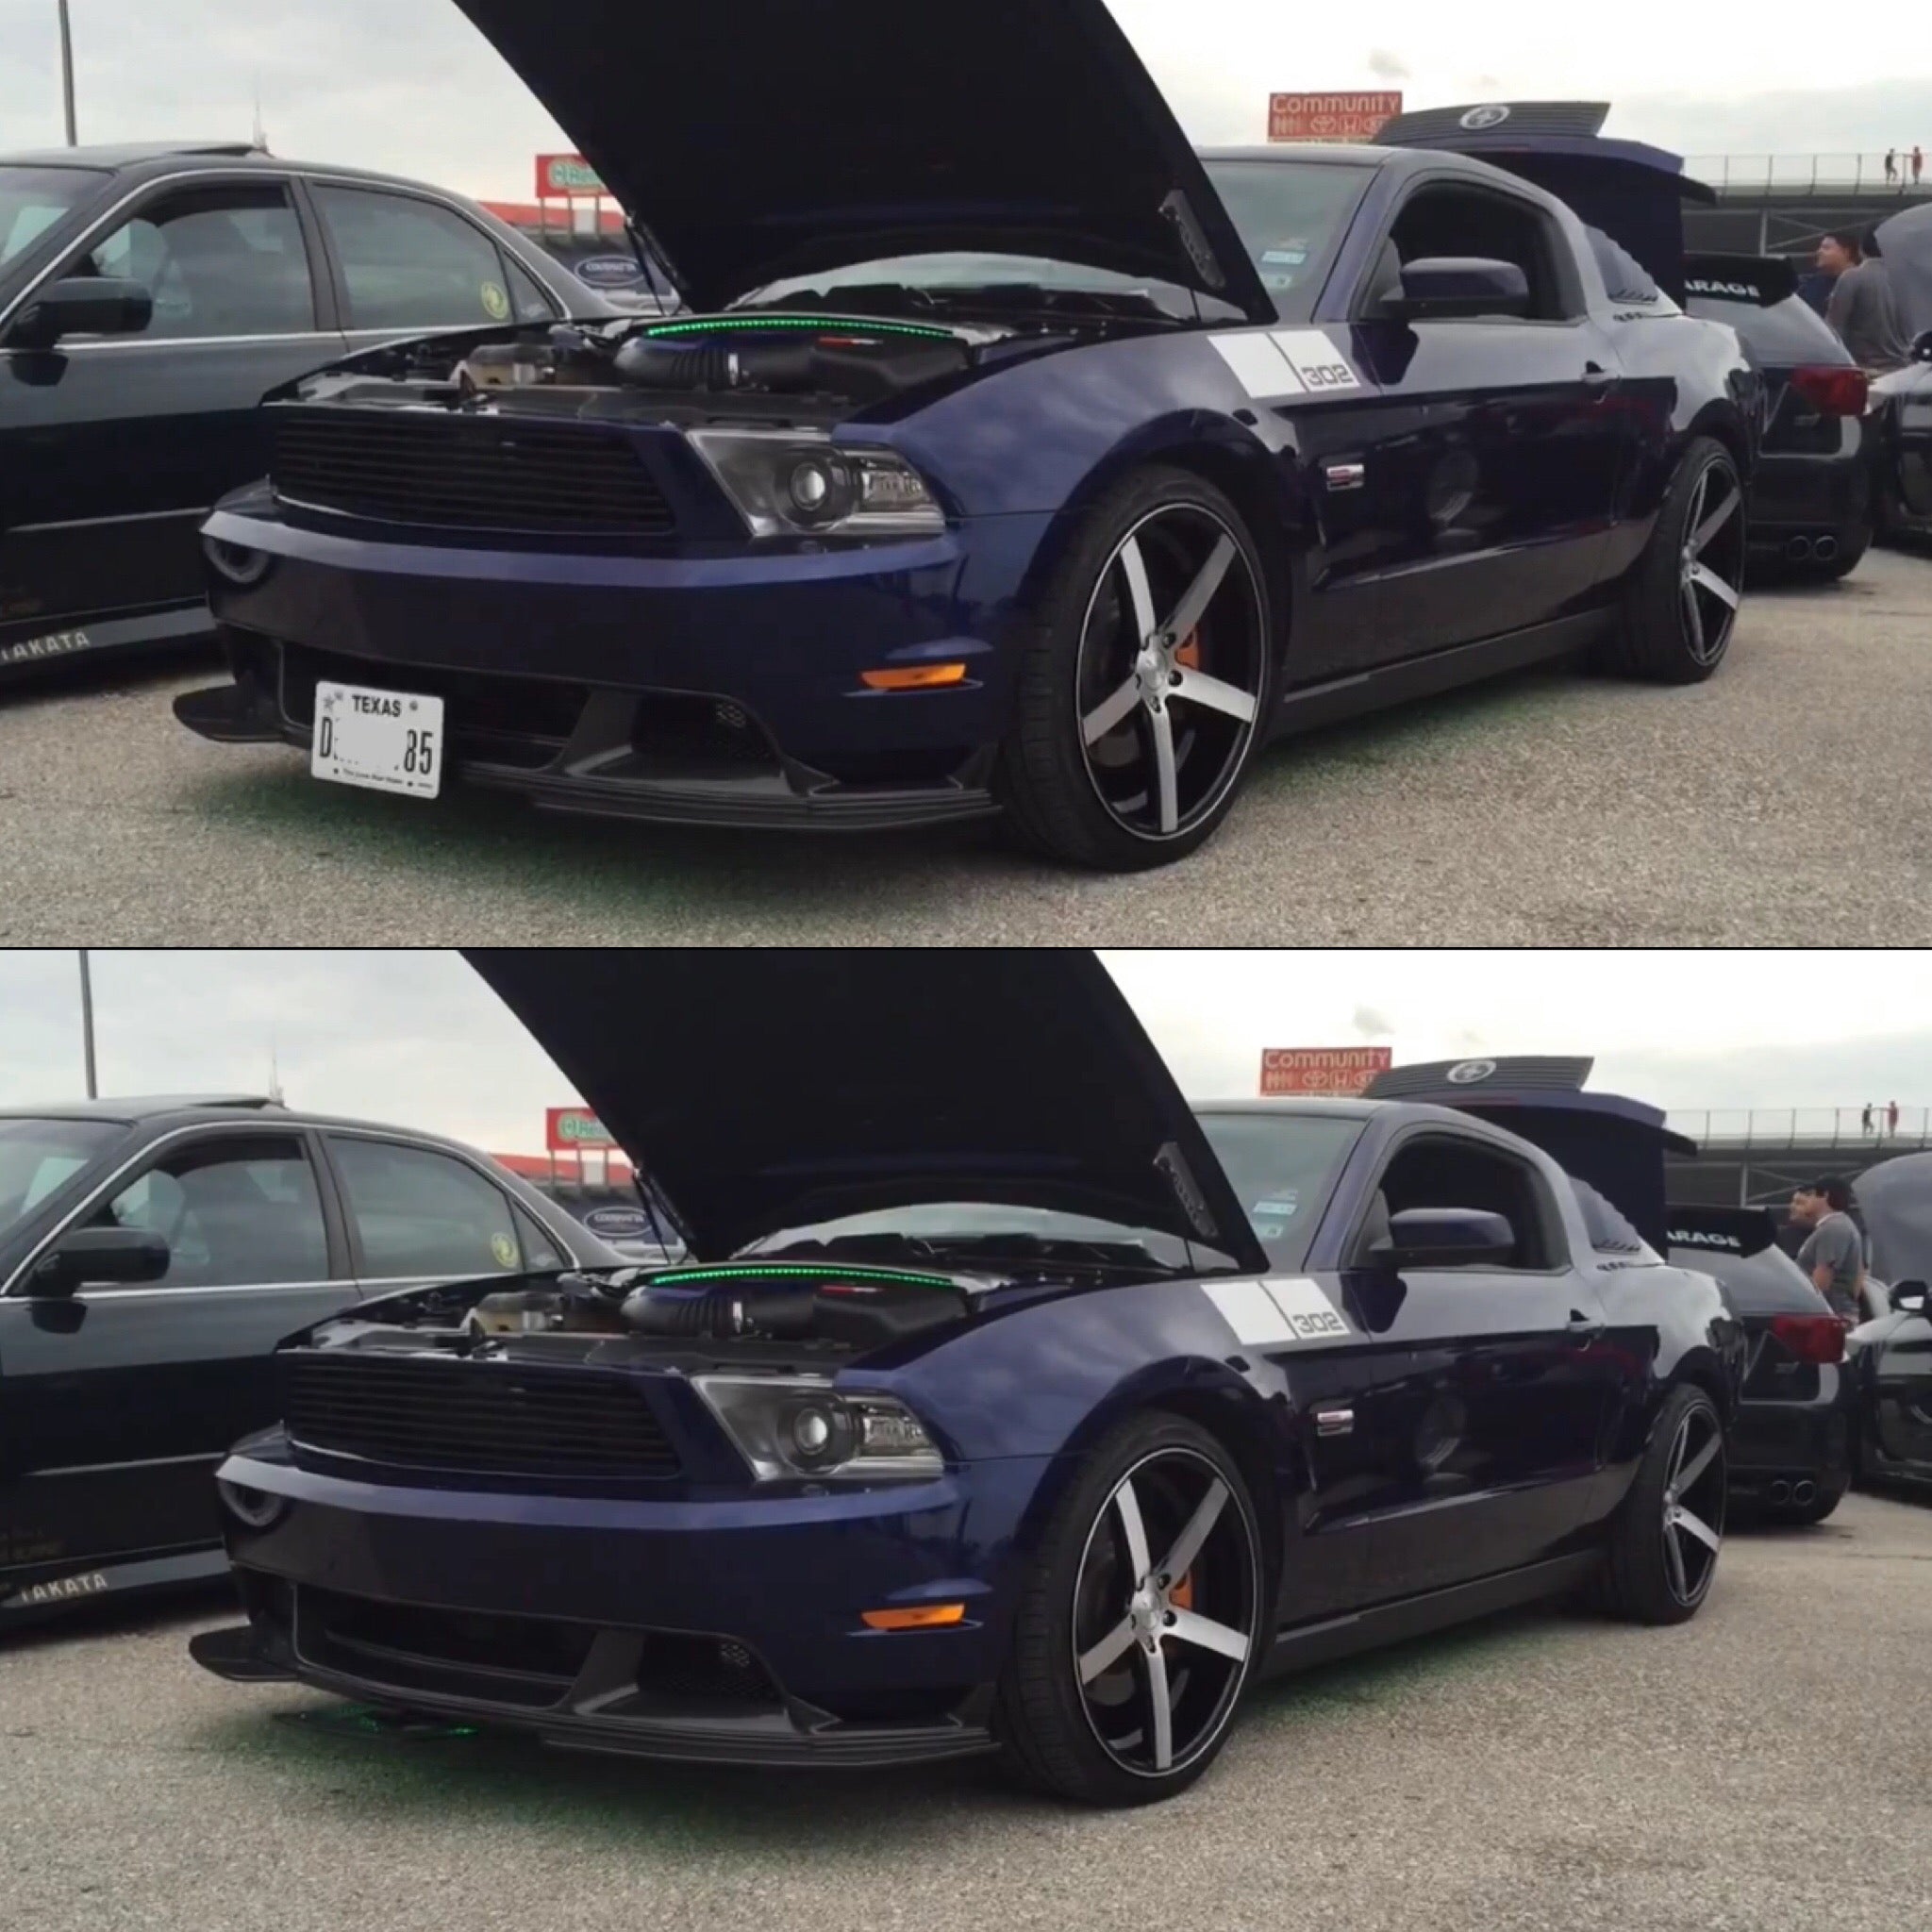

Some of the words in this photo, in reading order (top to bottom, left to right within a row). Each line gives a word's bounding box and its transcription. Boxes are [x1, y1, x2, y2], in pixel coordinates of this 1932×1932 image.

[1274, 94, 1399, 113] Community
[1301, 364, 1353, 386] 302
[352, 693, 401, 717] TEXAS
[1265, 1049, 1389, 1068] Community
[1292, 1311, 1344, 1333] 302
